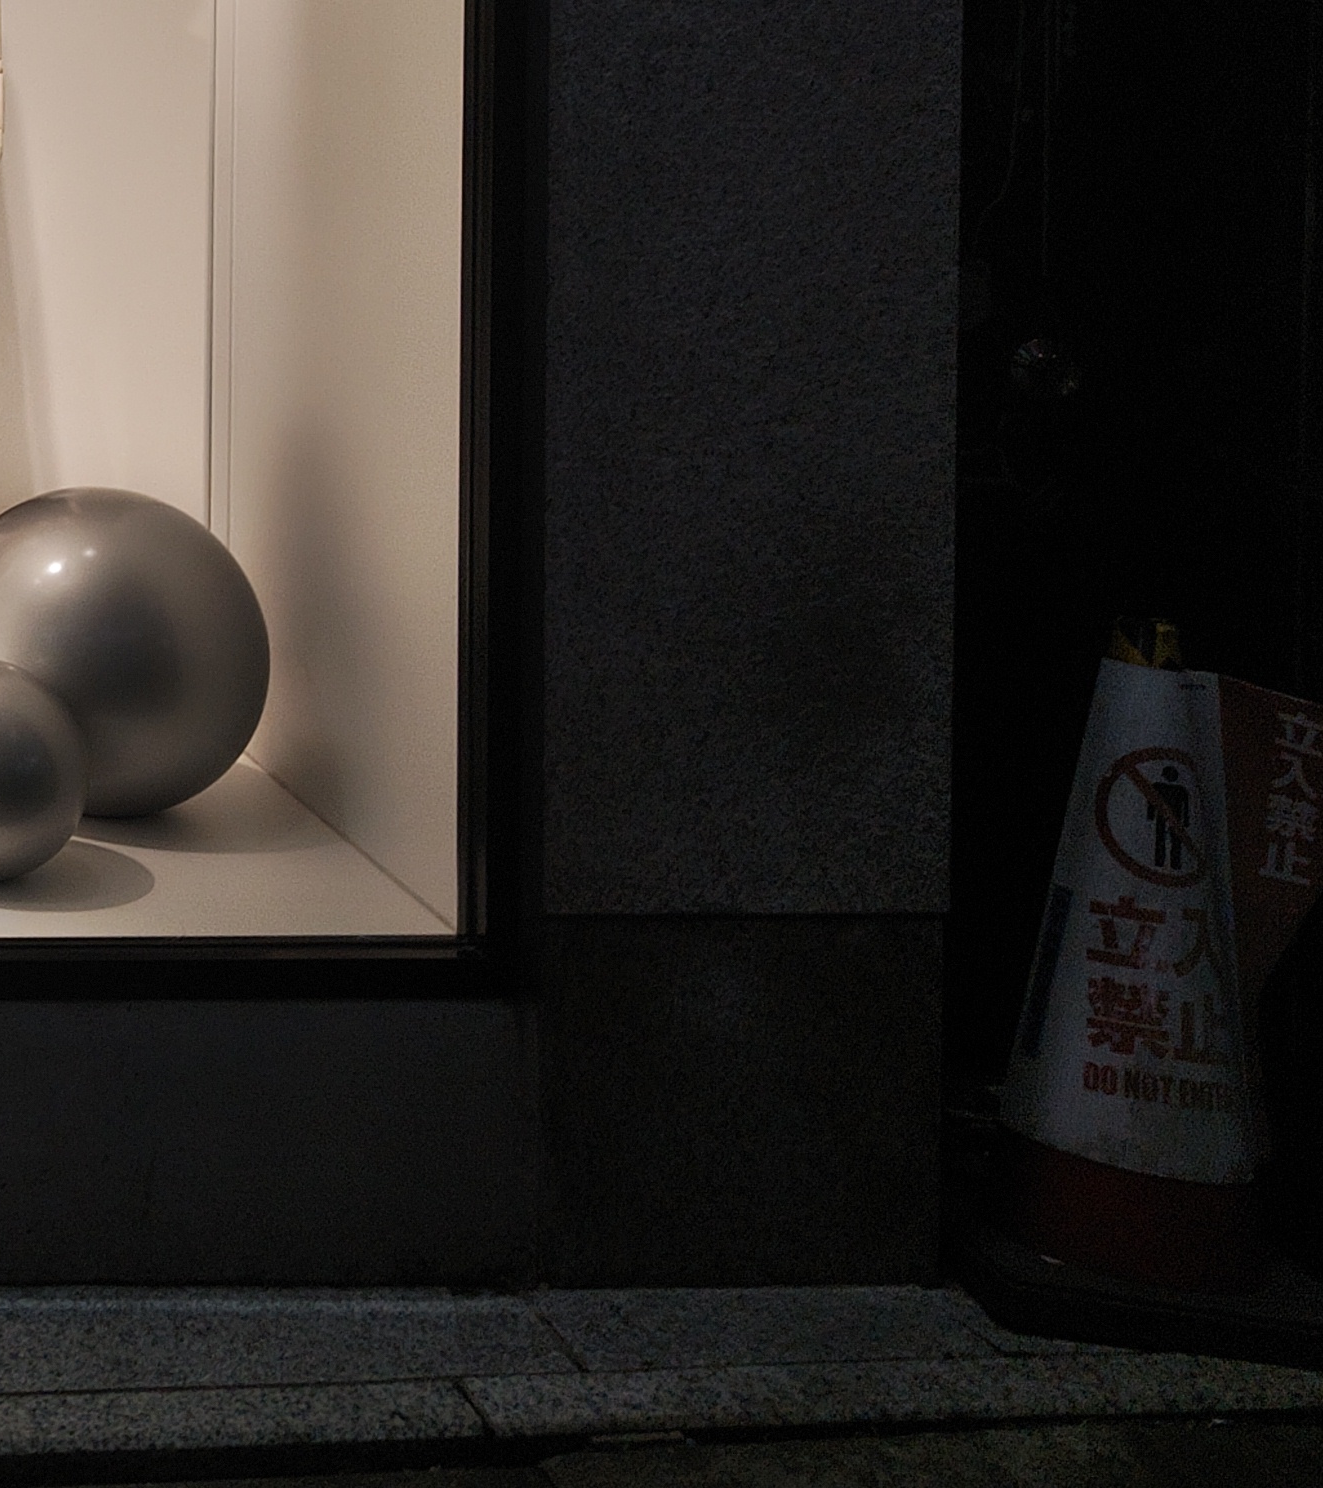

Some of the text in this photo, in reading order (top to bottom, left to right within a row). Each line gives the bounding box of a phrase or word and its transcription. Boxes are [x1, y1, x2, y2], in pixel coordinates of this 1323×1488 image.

[1258, 711, 1323, 887] 立入禁止
[1083, 1061, 1118, 1096] DO
[1124, 1068, 1173, 1105] NOT
